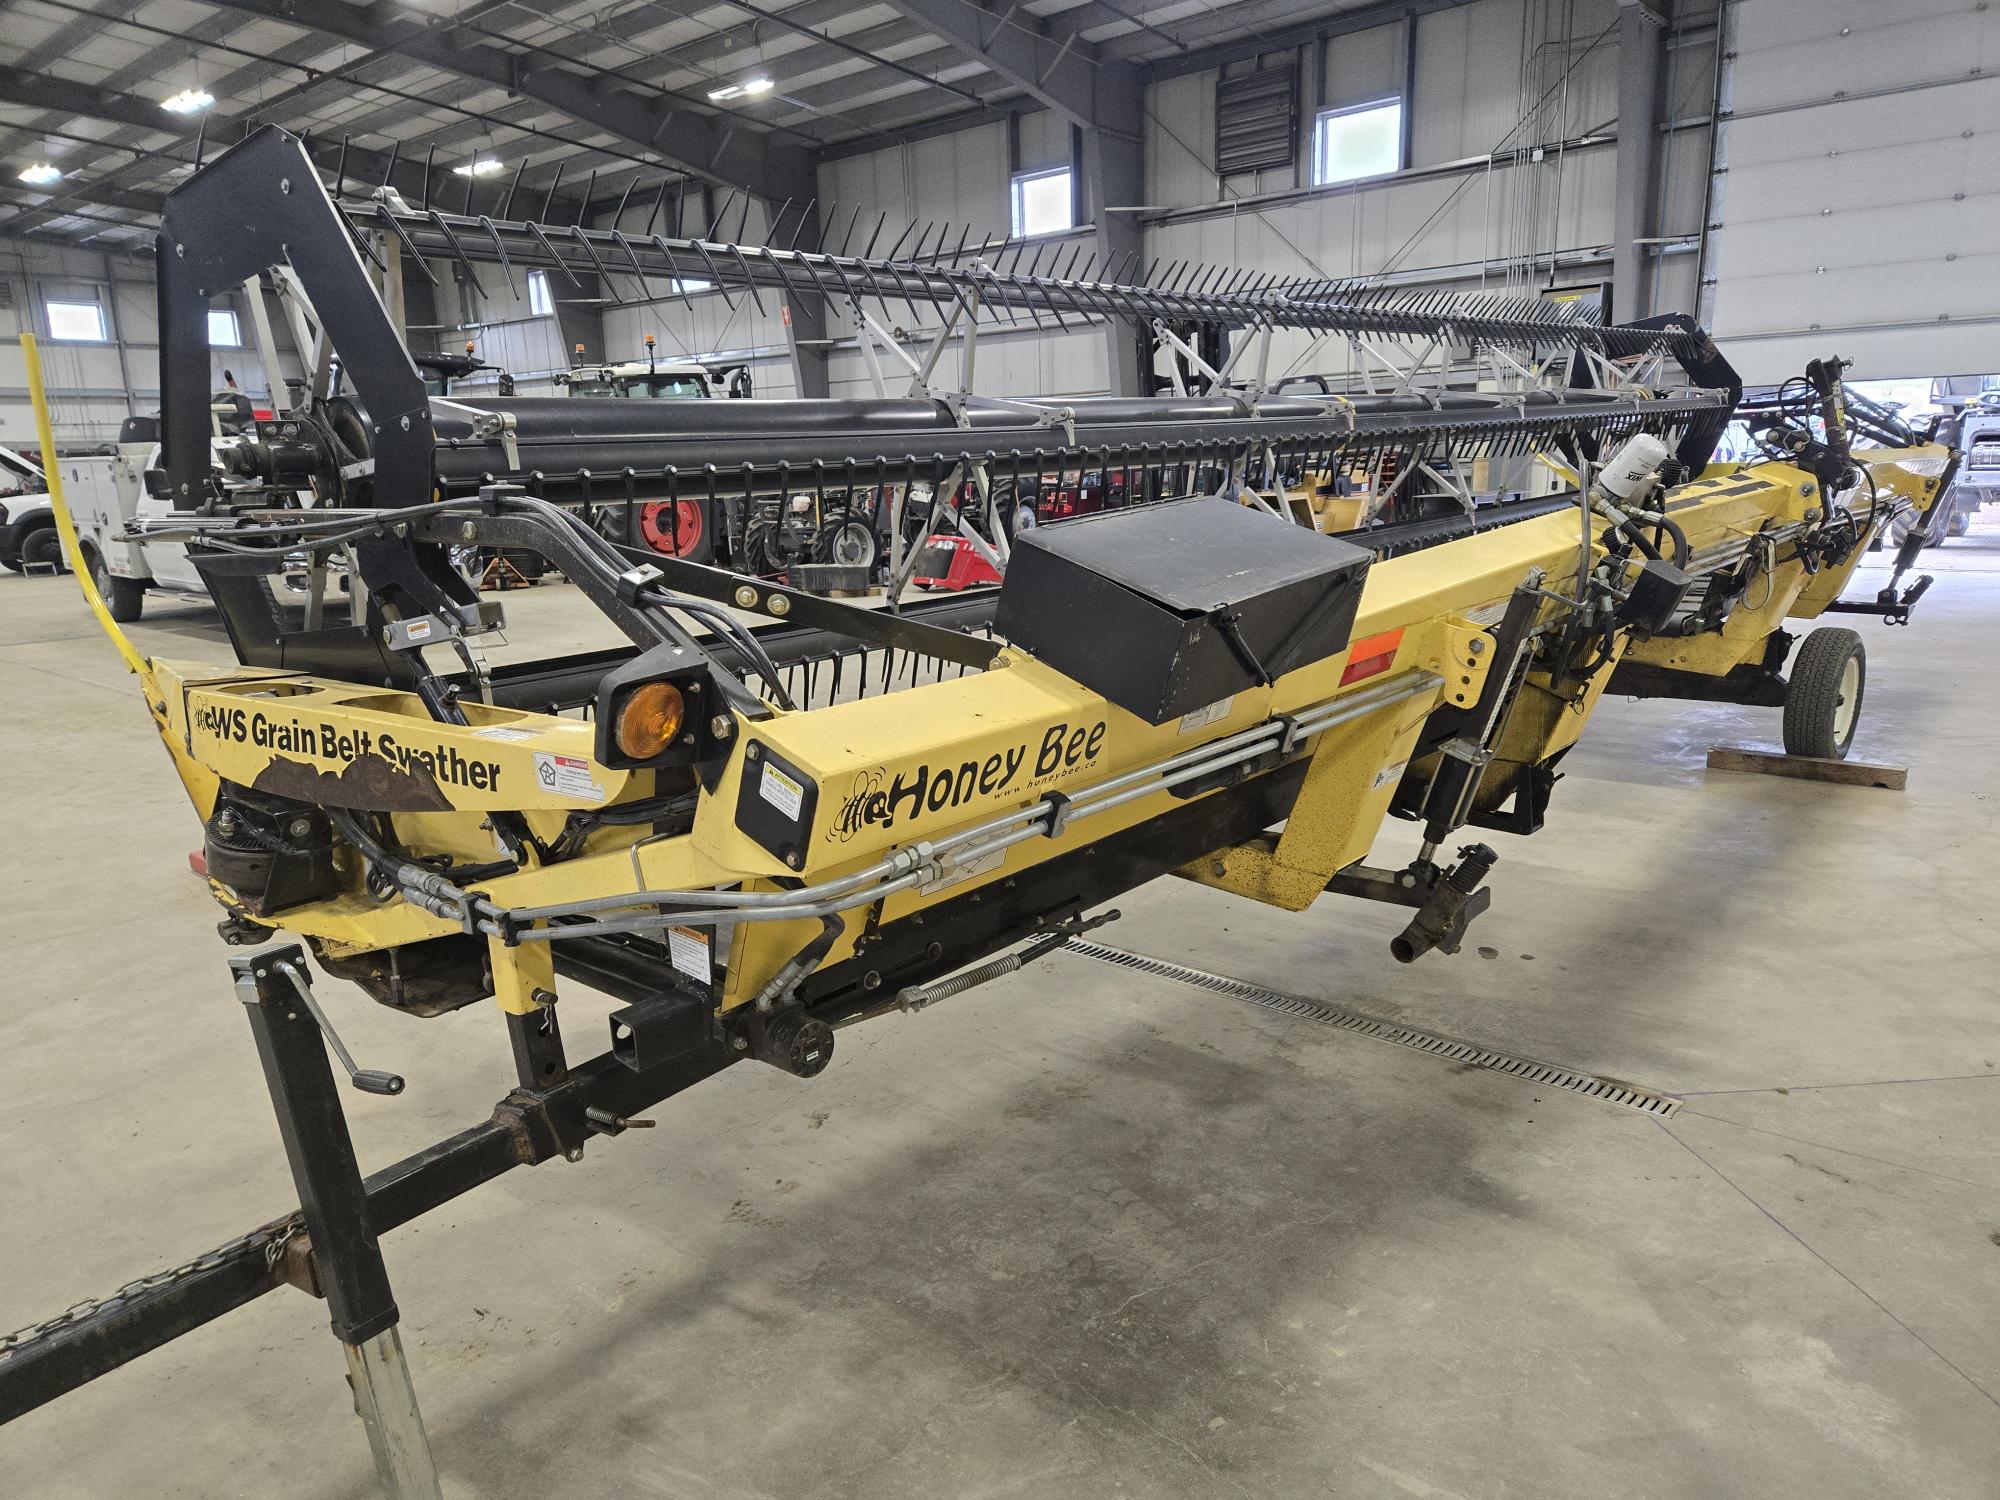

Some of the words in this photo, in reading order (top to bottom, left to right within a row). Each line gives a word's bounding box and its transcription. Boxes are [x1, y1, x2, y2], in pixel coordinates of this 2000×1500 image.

[211, 706, 247, 743] WS
[252, 713, 316, 755] Grain
[320, 724, 372, 762] Belt
[883, 745, 1026, 828] Honey
[1035, 721, 1106, 778] Bee
